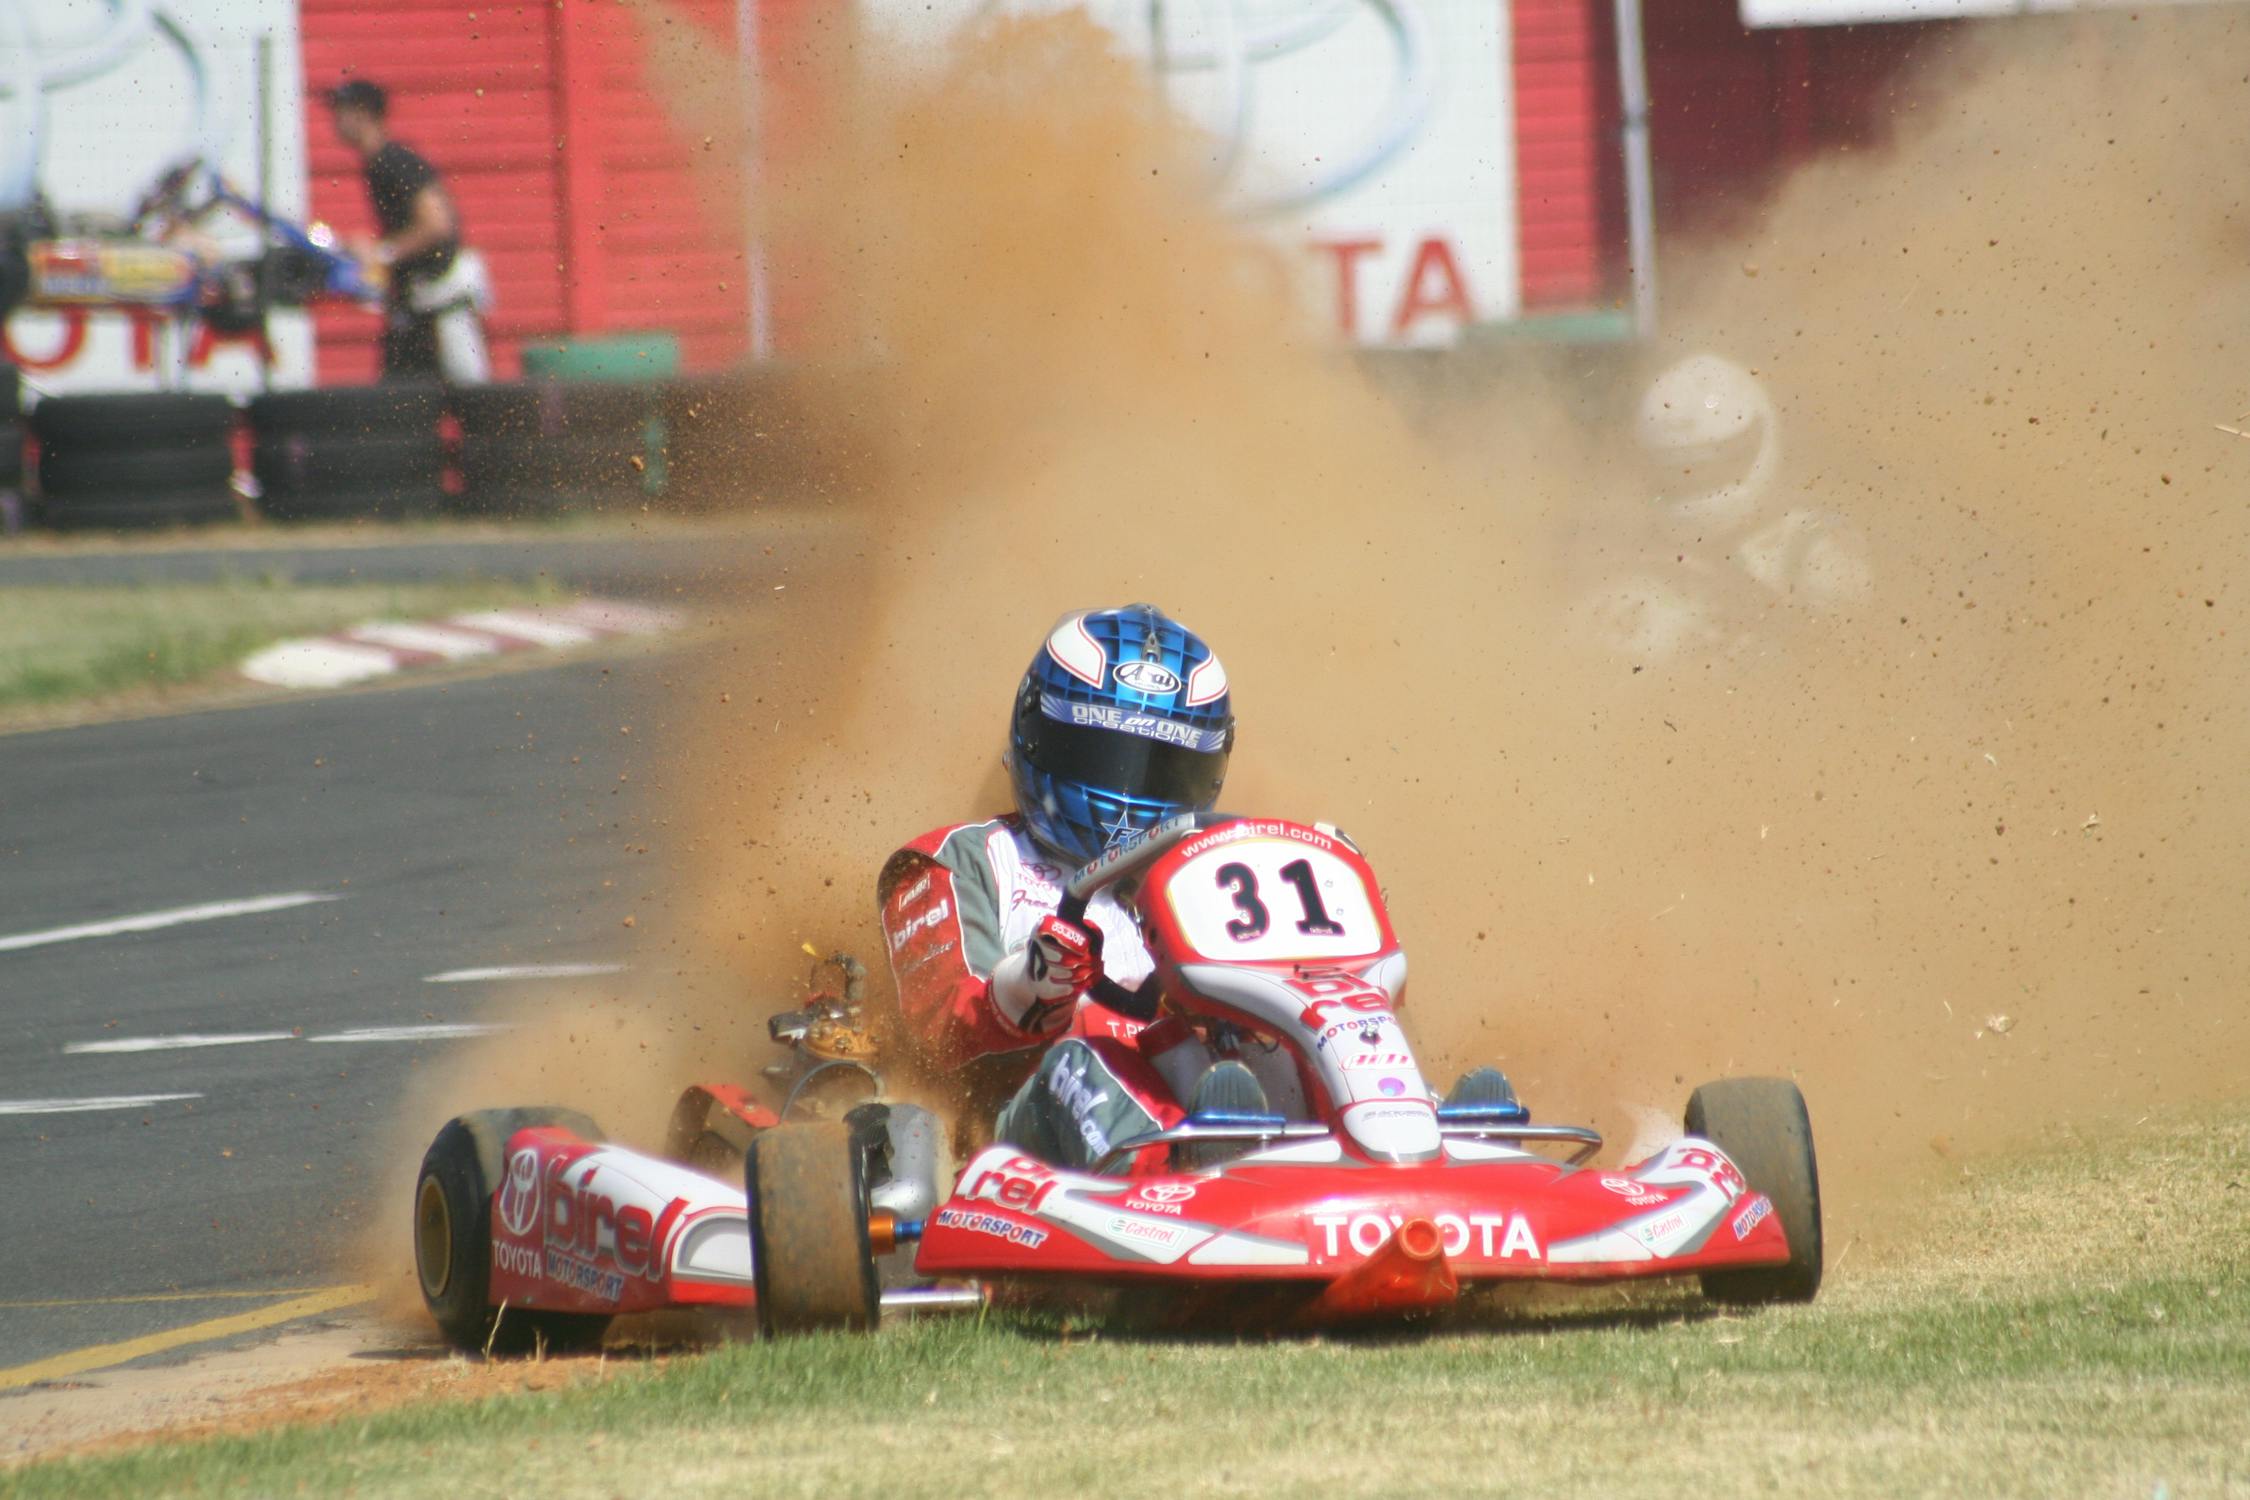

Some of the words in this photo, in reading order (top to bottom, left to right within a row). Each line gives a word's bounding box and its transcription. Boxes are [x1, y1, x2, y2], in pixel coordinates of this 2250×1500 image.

[1240, 237, 1476, 340] TA
[1120, 664, 1173, 688] Aai
[1072, 704, 1122, 723] ONE
[1157, 721, 1203, 743] ONE
[1215, 858, 1346, 943] 31
[1125, 1199, 1183, 1216] TOYOTA
[1652, 1214, 1687, 1237] Castrol
[938, 1209, 1047, 1249] MOTORSPORT
[1125, 1220, 1176, 1244] Castrol
[1312, 1213, 1541, 1260] TOOTA
[492, 1239, 542, 1280] TOYOTA
